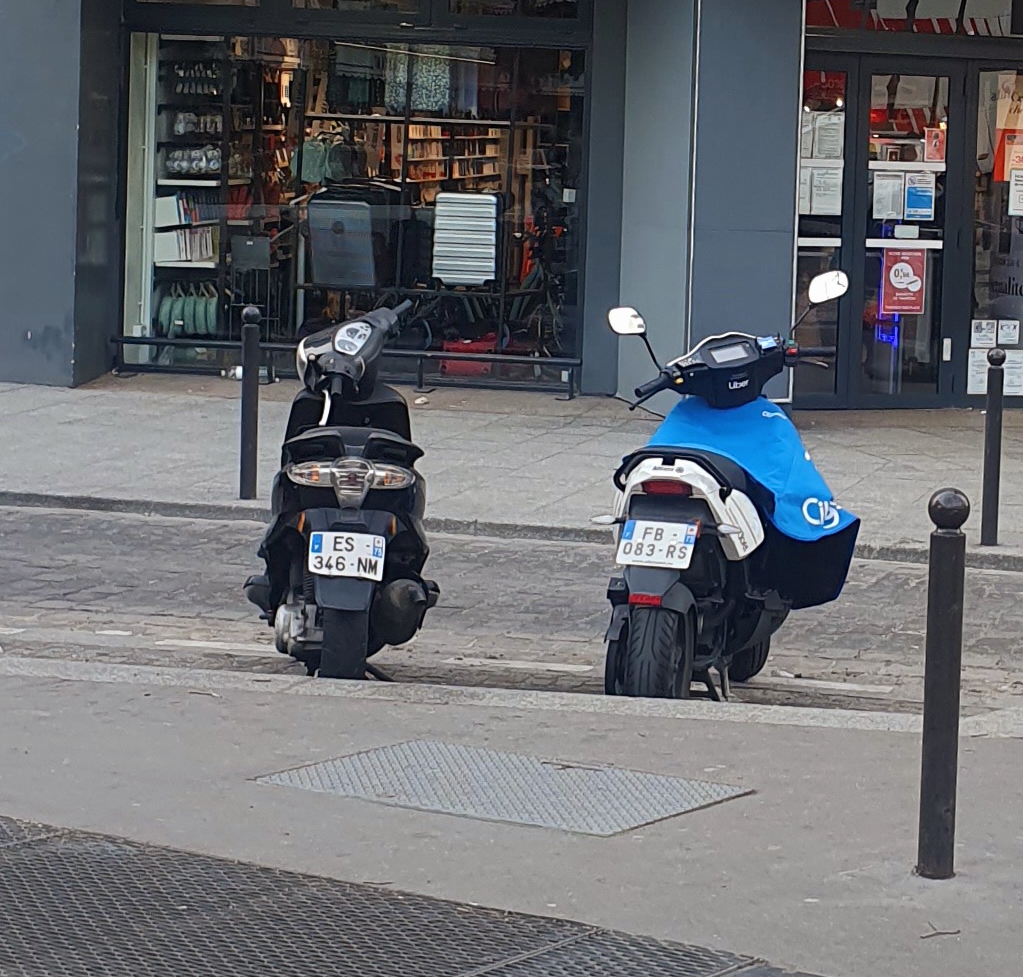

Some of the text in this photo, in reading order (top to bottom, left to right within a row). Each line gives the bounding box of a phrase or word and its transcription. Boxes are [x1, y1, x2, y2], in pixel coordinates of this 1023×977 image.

[728, 379, 750, 390] Uber
[642, 526, 665, 541] FB
[333, 536, 355, 552] ES
